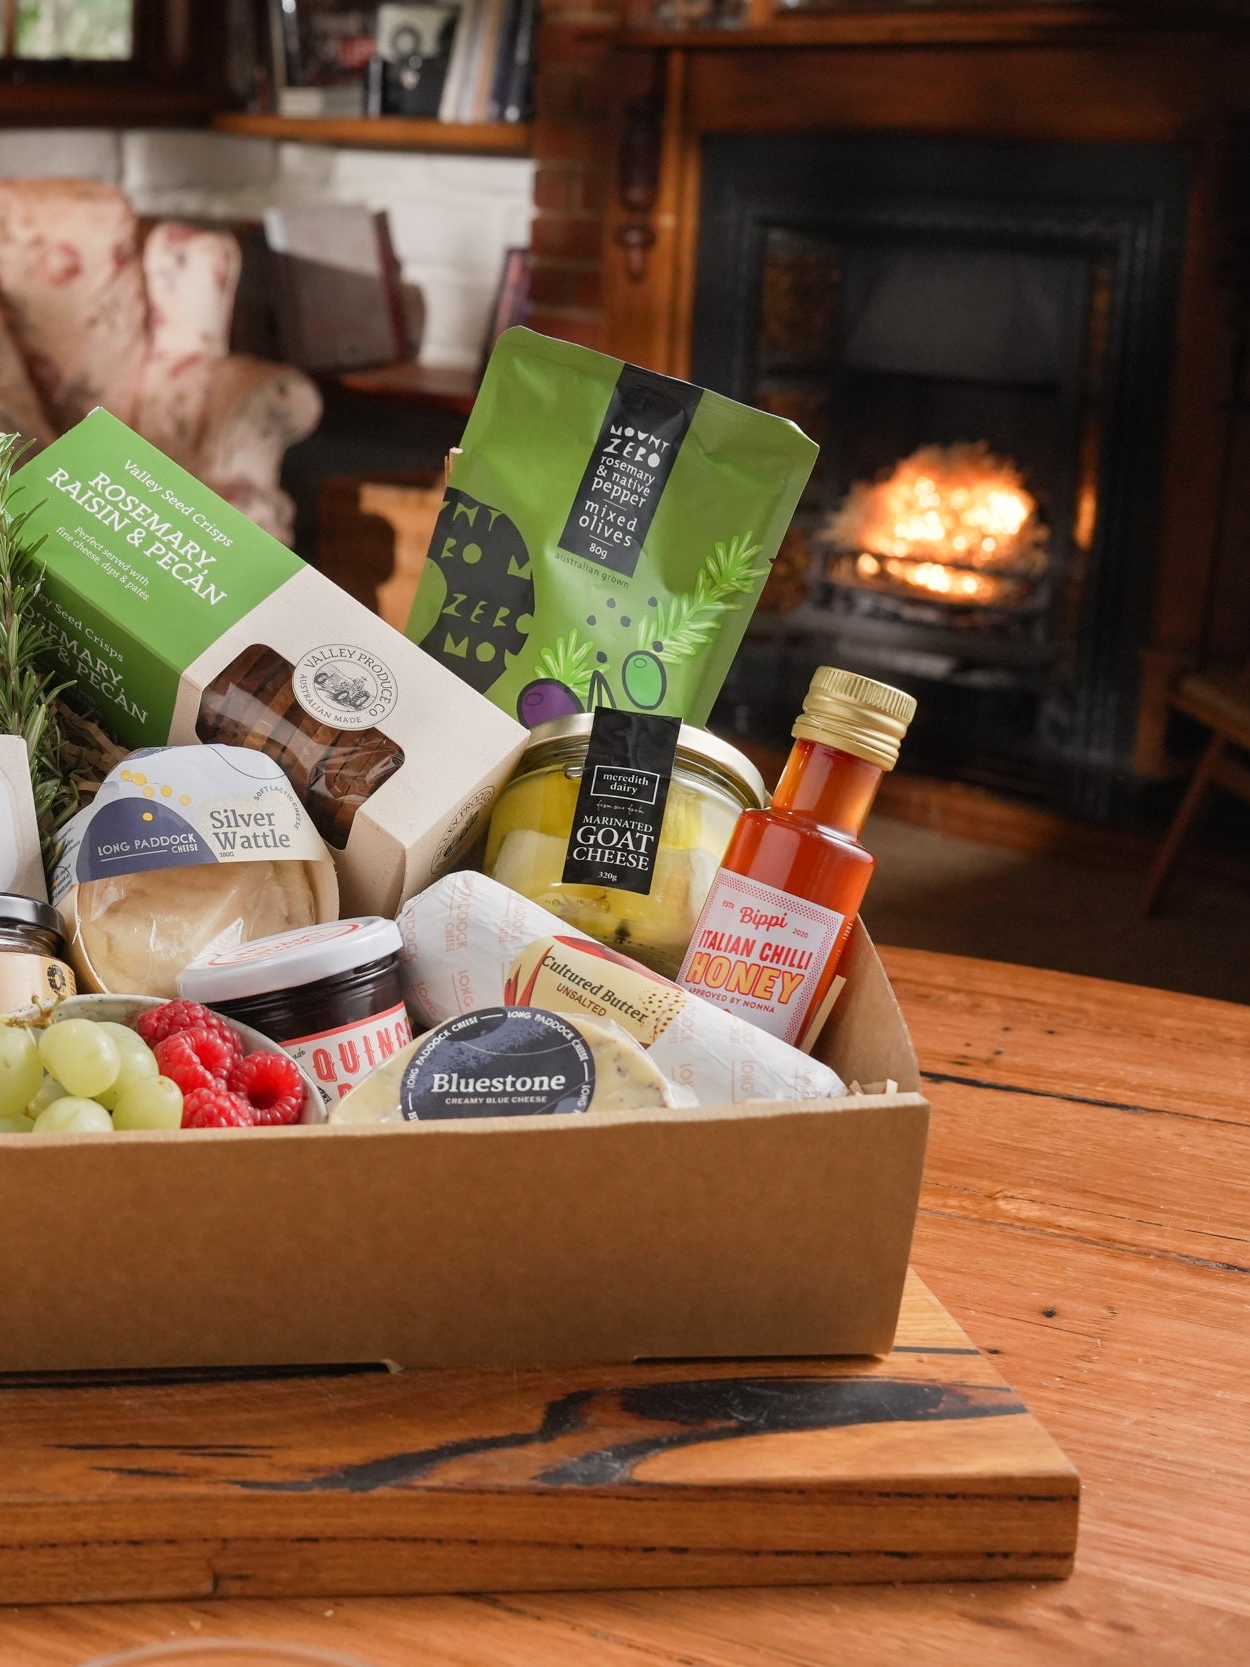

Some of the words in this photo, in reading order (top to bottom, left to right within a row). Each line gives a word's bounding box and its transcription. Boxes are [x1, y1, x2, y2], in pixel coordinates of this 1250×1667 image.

[610, 424, 670, 453] MOUNT
[603, 438, 661, 468] ZERO
[596, 465, 608, 478] &
[611, 472, 651, 497] native
[600, 455, 656, 486] rosemary
[123, 459, 164, 494] Valley
[160, 489, 194, 517] Seed
[191, 513, 233, 547] Crisps
[591, 477, 647, 509] pepper
[47, 467, 131, 533] RAISIN
[126, 528, 147, 548] &
[584, 500, 638, 532] mixed
[88, 472, 217, 575] ROSEMARY,
[579, 515, 633, 547] olives
[55, 526, 74, 542] fine
[72, 540, 101, 566] cheese,
[101, 562, 120, 578] dips
[119, 574, 128, 583] &
[74, 526, 104, 551] Perfect
[102, 549, 131, 571] served
[129, 569, 150, 587] with
[589, 542, 608, 560] 80g
[554, 551, 600, 577] australian
[600, 571, 630, 589] grown
[55, 603, 82, 630] Seed
[86, 629, 124, 663] Crisps
[57, 647, 70, 666] &
[303, 648, 356, 669] VALLEY
[357, 653, 393, 705] PRODUCE
[300, 673, 332, 719] AUSTRALIAN
[333, 716, 362, 724] MADE
[253, 785, 269, 801] SOFT
[269, 785, 293, 802] LACTIC
[603, 773, 649, 786] meredith
[610, 783, 638, 795] dairy
[209, 808, 276, 830] Silver
[583, 815, 653, 833] MARINATED
[98, 840, 131, 857] LONG
[134, 832, 198, 851] PADDOCK
[171, 843, 199, 854] CHEESE
[212, 829, 291, 852] Wattle
[576, 825, 655, 854] GOAT
[573, 846, 650, 871] CHEESE
[597, 871, 618, 882] 320g
[739, 906, 788, 932] Bippi
[792, 927, 809, 939] 2020
[698, 929, 756, 959] ITALIAN
[758, 941, 814, 971] CHILLI
[458, 969, 474, 1008] LONG
[542, 955, 604, 996] Cultured
[600, 989, 649, 1023] Butter
[685, 951, 805, 1006] HONEY
[556, 983, 607, 1017] UNSALTED
[689, 987, 729, 1004] APPROVED
[730, 996, 741, 1006] BY
[742, 999, 775, 1014] NONNA
[451, 1016, 479, 1032] CHEESE
[507, 1011, 532, 1019] LONG
[534, 1014, 575, 1040] PADDOCK
[415, 1030, 452, 1066] PADDOCK
[571, 1040, 589, 1061] CHEESE
[406, 1067, 419, 1089] LONG
[430, 1072, 567, 1095] Bluestone
[445, 1097, 484, 1105] CREAMY
[486, 1097, 510, 1105] BLUE
[511, 1095, 547, 1104] CHEESE
[577, 1085, 590, 1107] LONG
